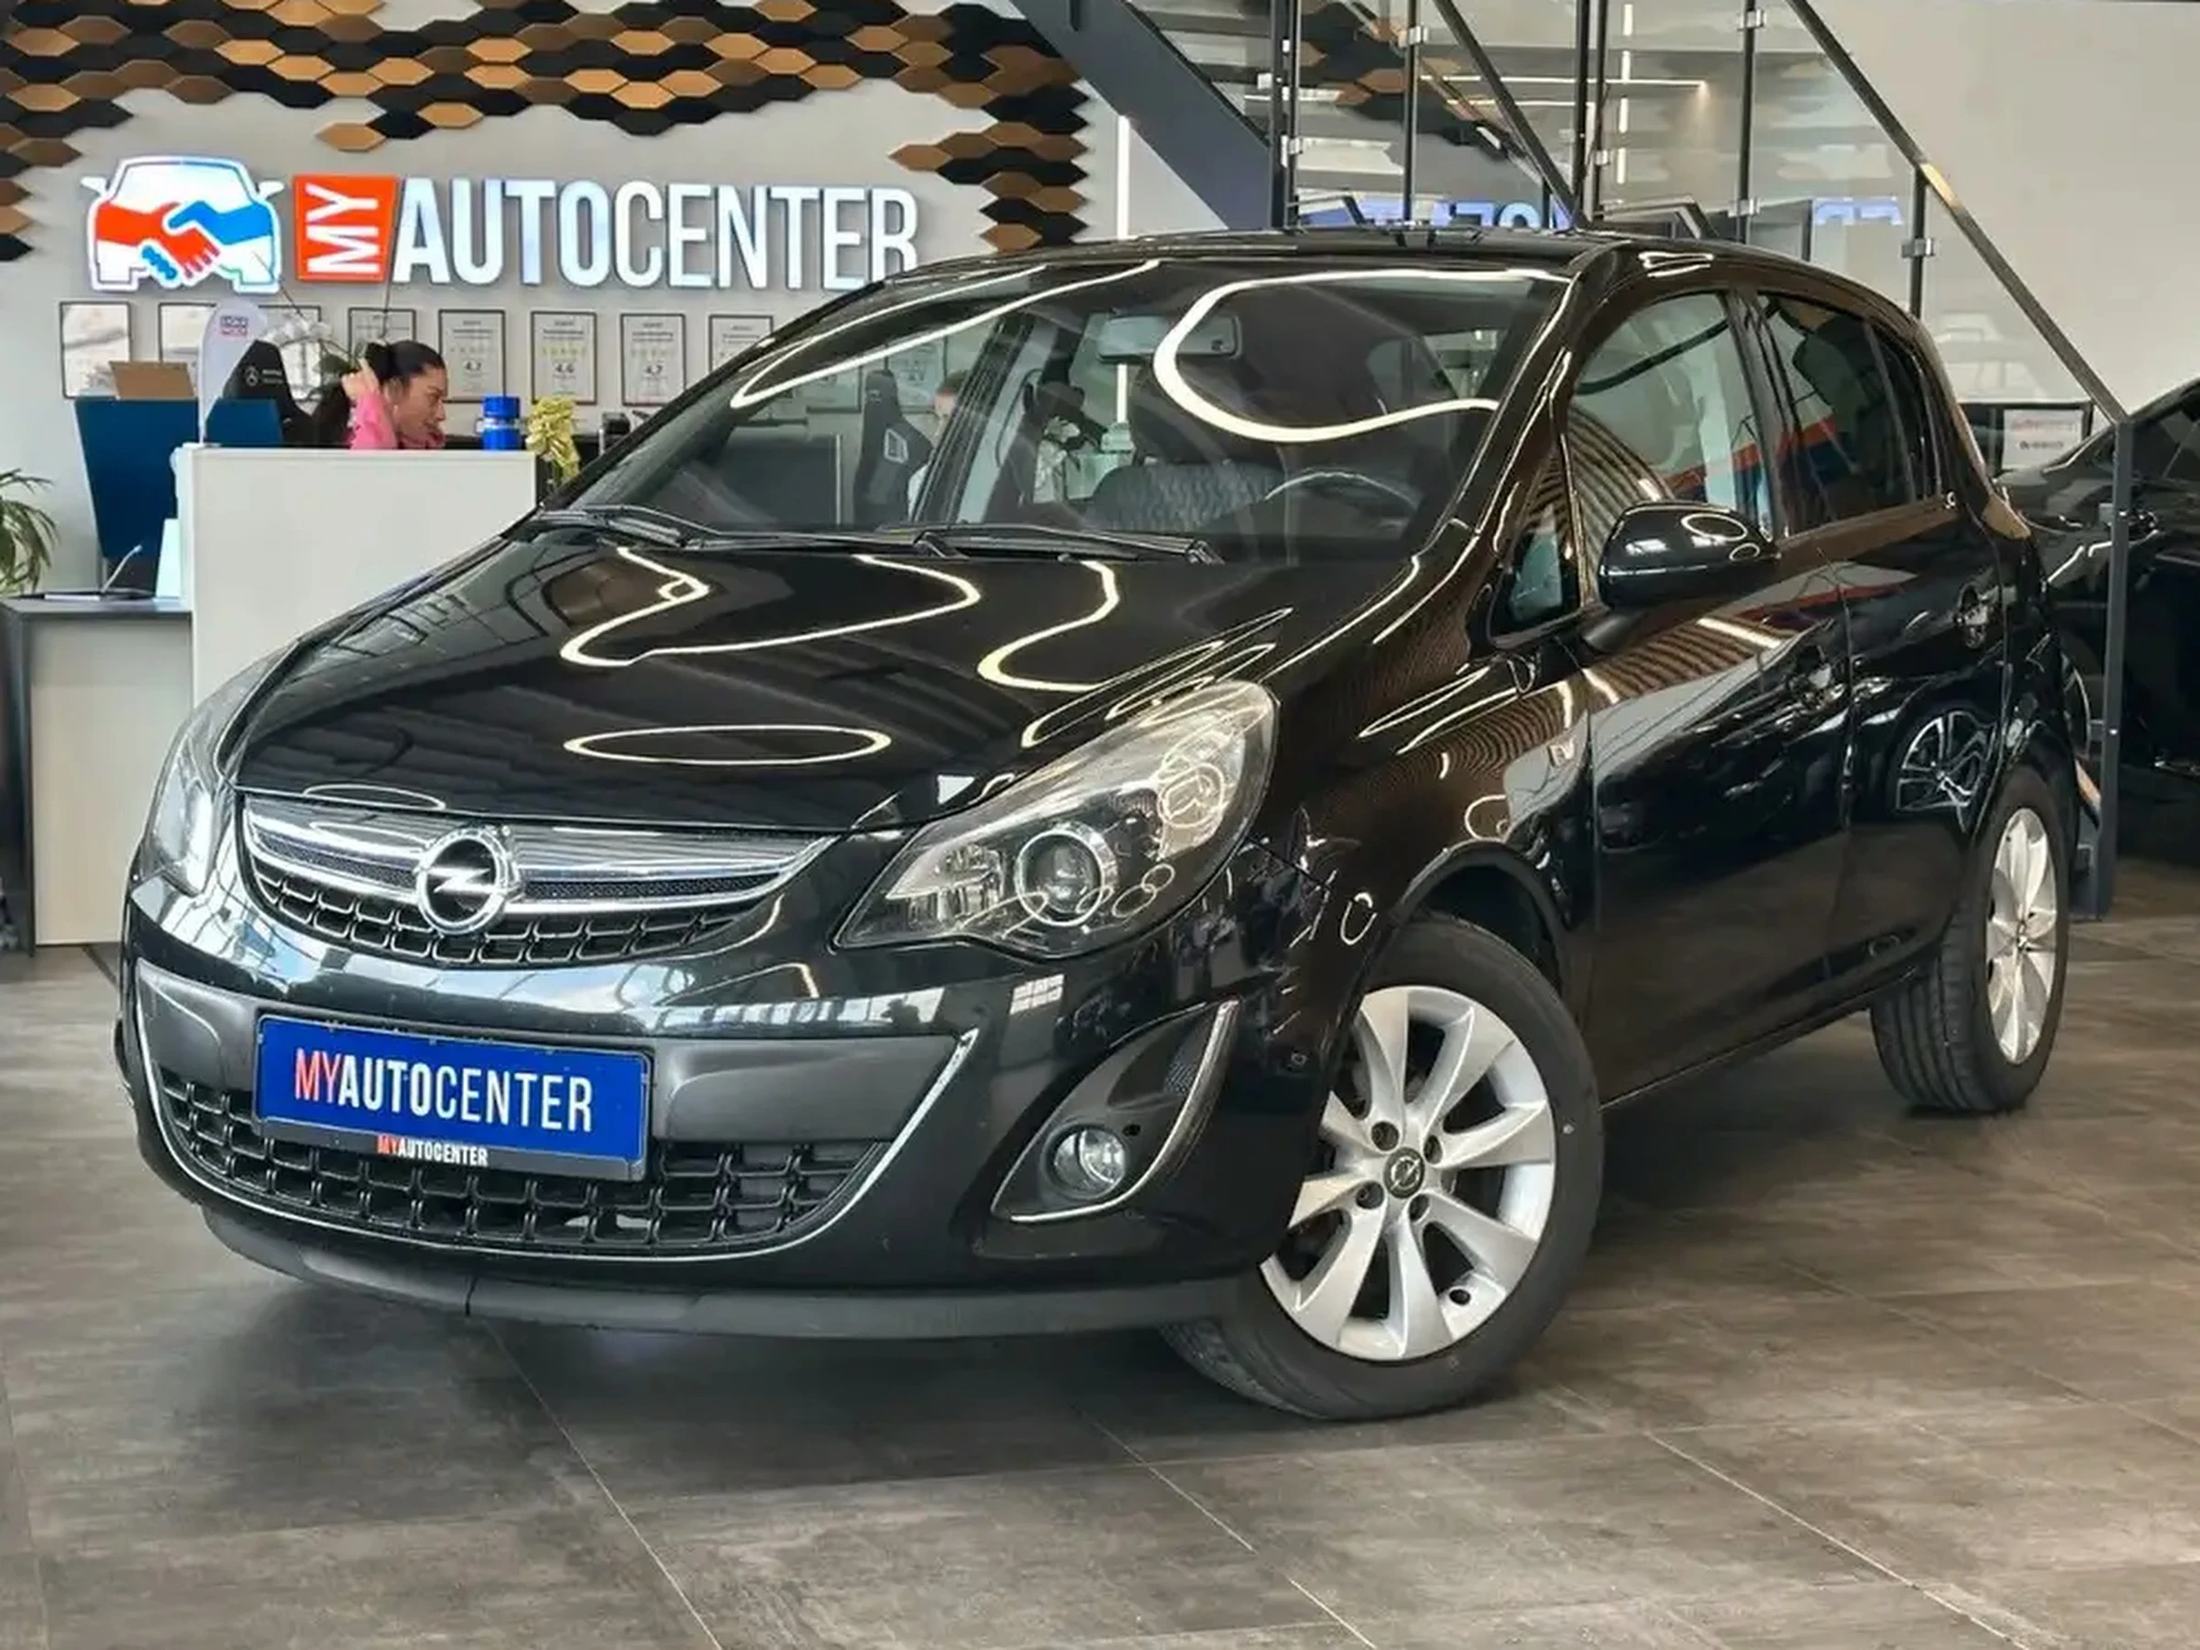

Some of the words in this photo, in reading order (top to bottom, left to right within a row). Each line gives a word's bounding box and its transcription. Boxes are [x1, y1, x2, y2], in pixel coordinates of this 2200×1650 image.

[305, 183, 381, 274] MY
[393, 177, 919, 290] AUTOCENTER
[294, 1047, 594, 1133] MYAUTOCENTER
[377, 1134, 489, 1168] MYAUTOCENTER
